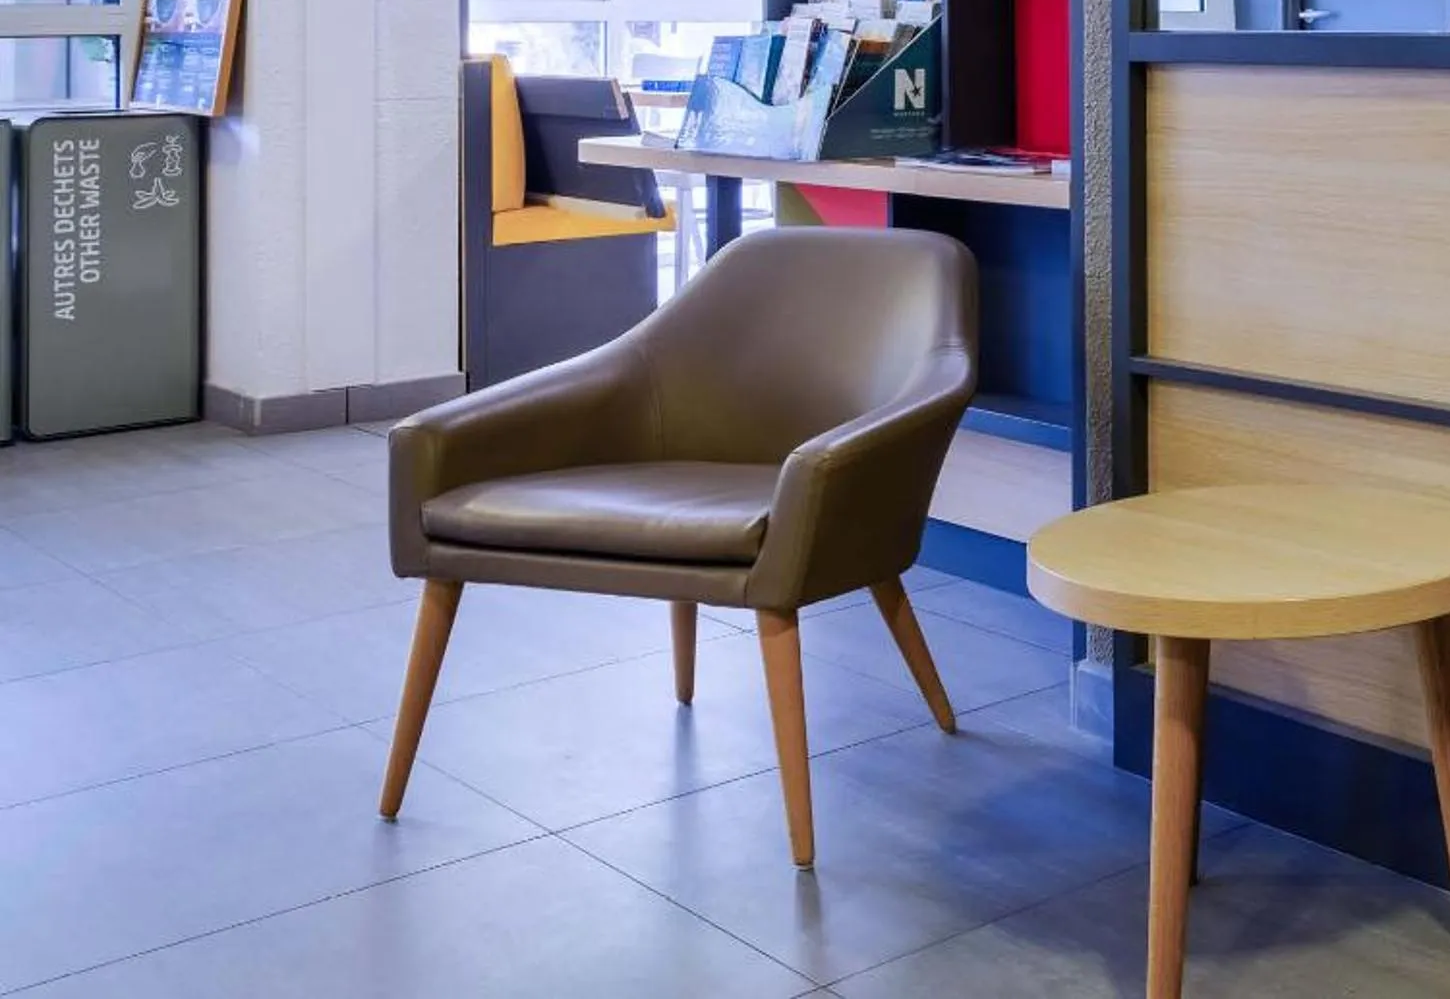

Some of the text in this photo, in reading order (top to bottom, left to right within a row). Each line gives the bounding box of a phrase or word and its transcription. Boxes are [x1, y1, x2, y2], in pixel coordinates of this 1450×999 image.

[894, 68, 926, 110] N
[53, 139, 76, 321] AUTRES DECHETS
[78, 138, 101, 284] OTHER WASTE
